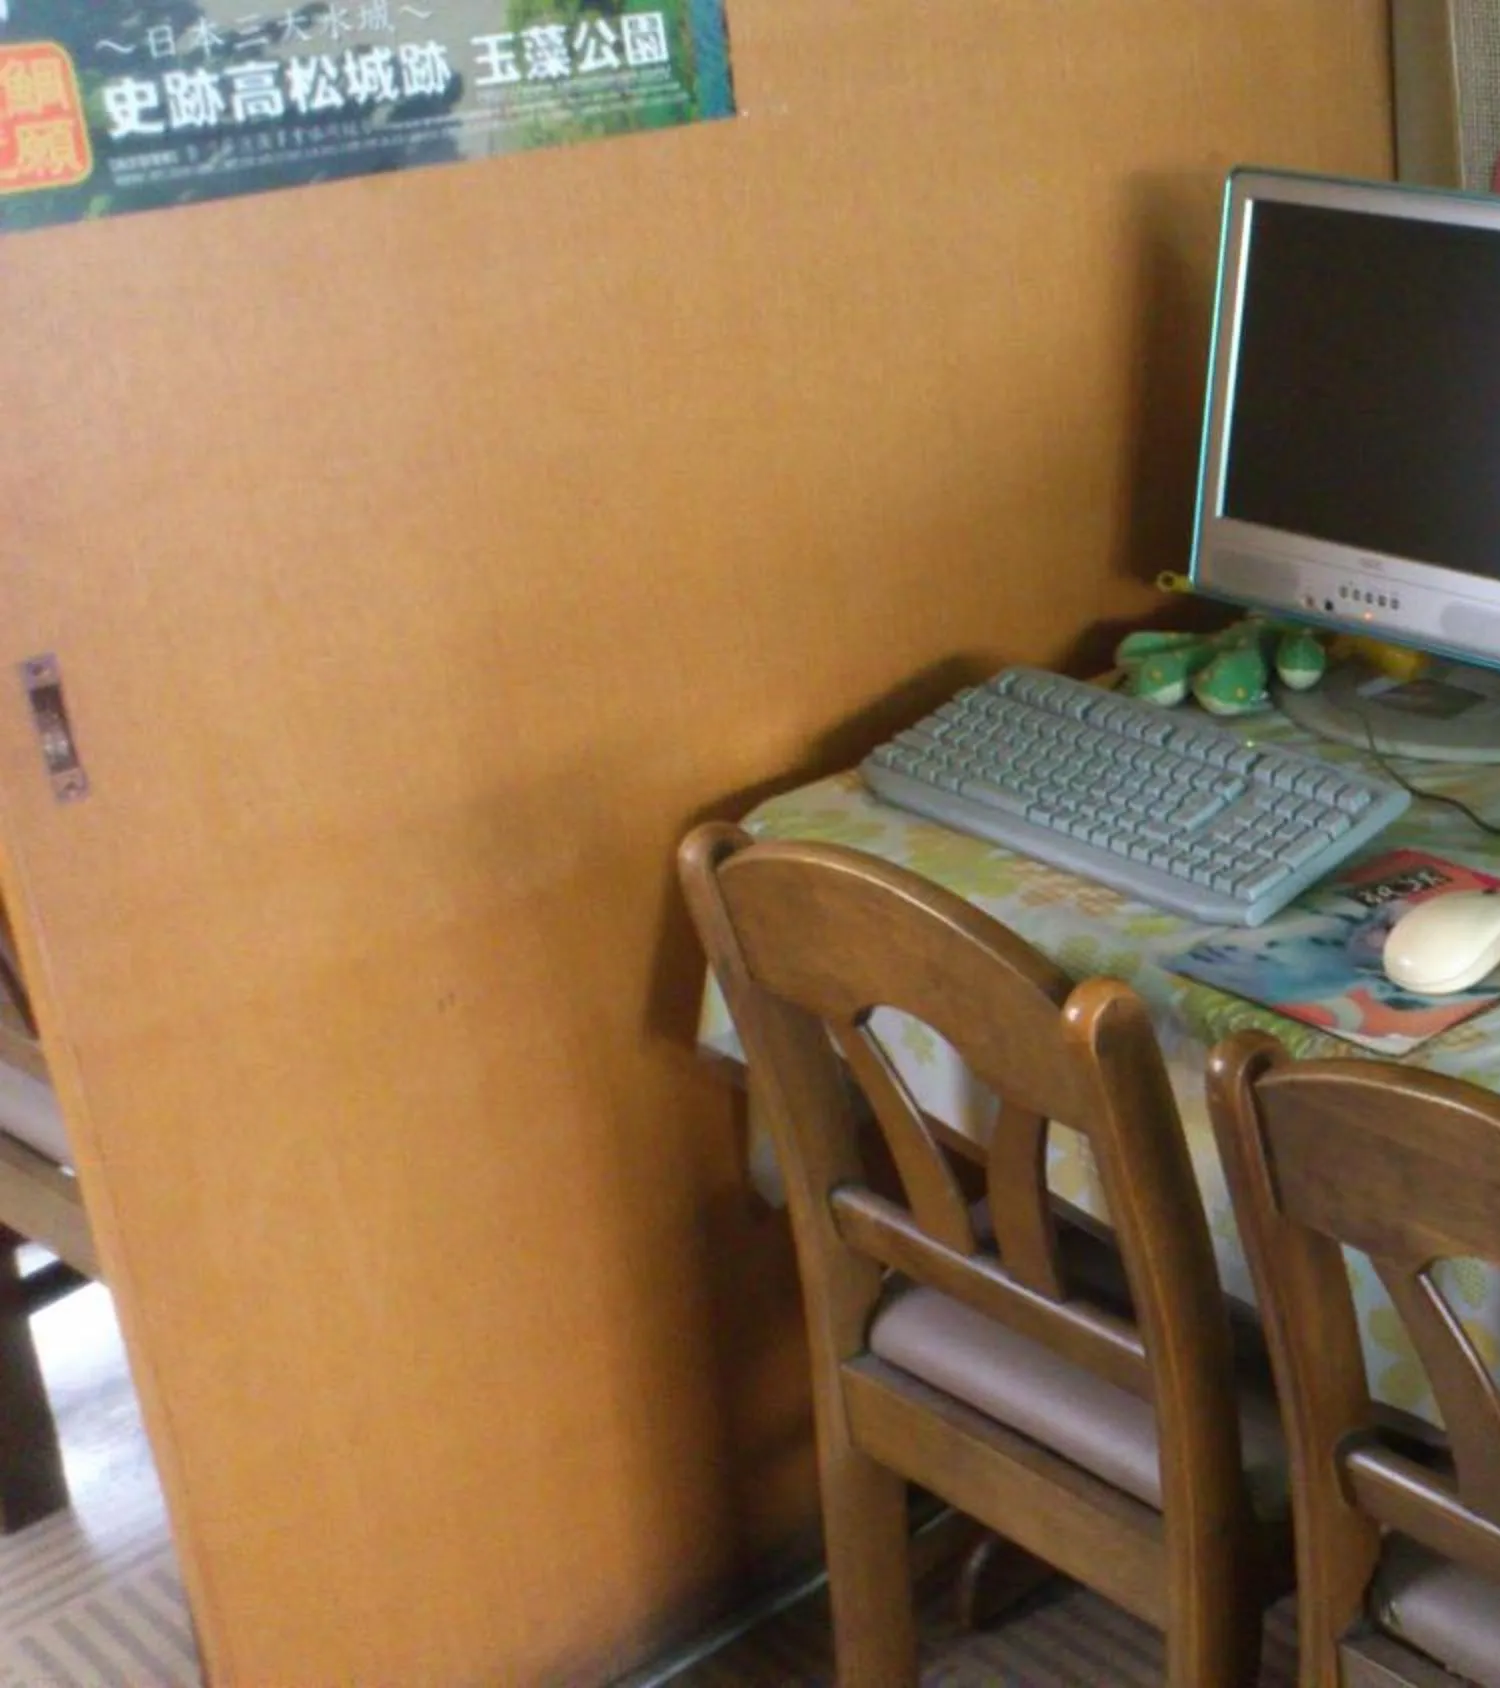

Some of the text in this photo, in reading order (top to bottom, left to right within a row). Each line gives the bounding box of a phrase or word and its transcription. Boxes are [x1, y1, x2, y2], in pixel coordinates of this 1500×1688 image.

[103, 41, 452, 140] 史跡高松城跡
